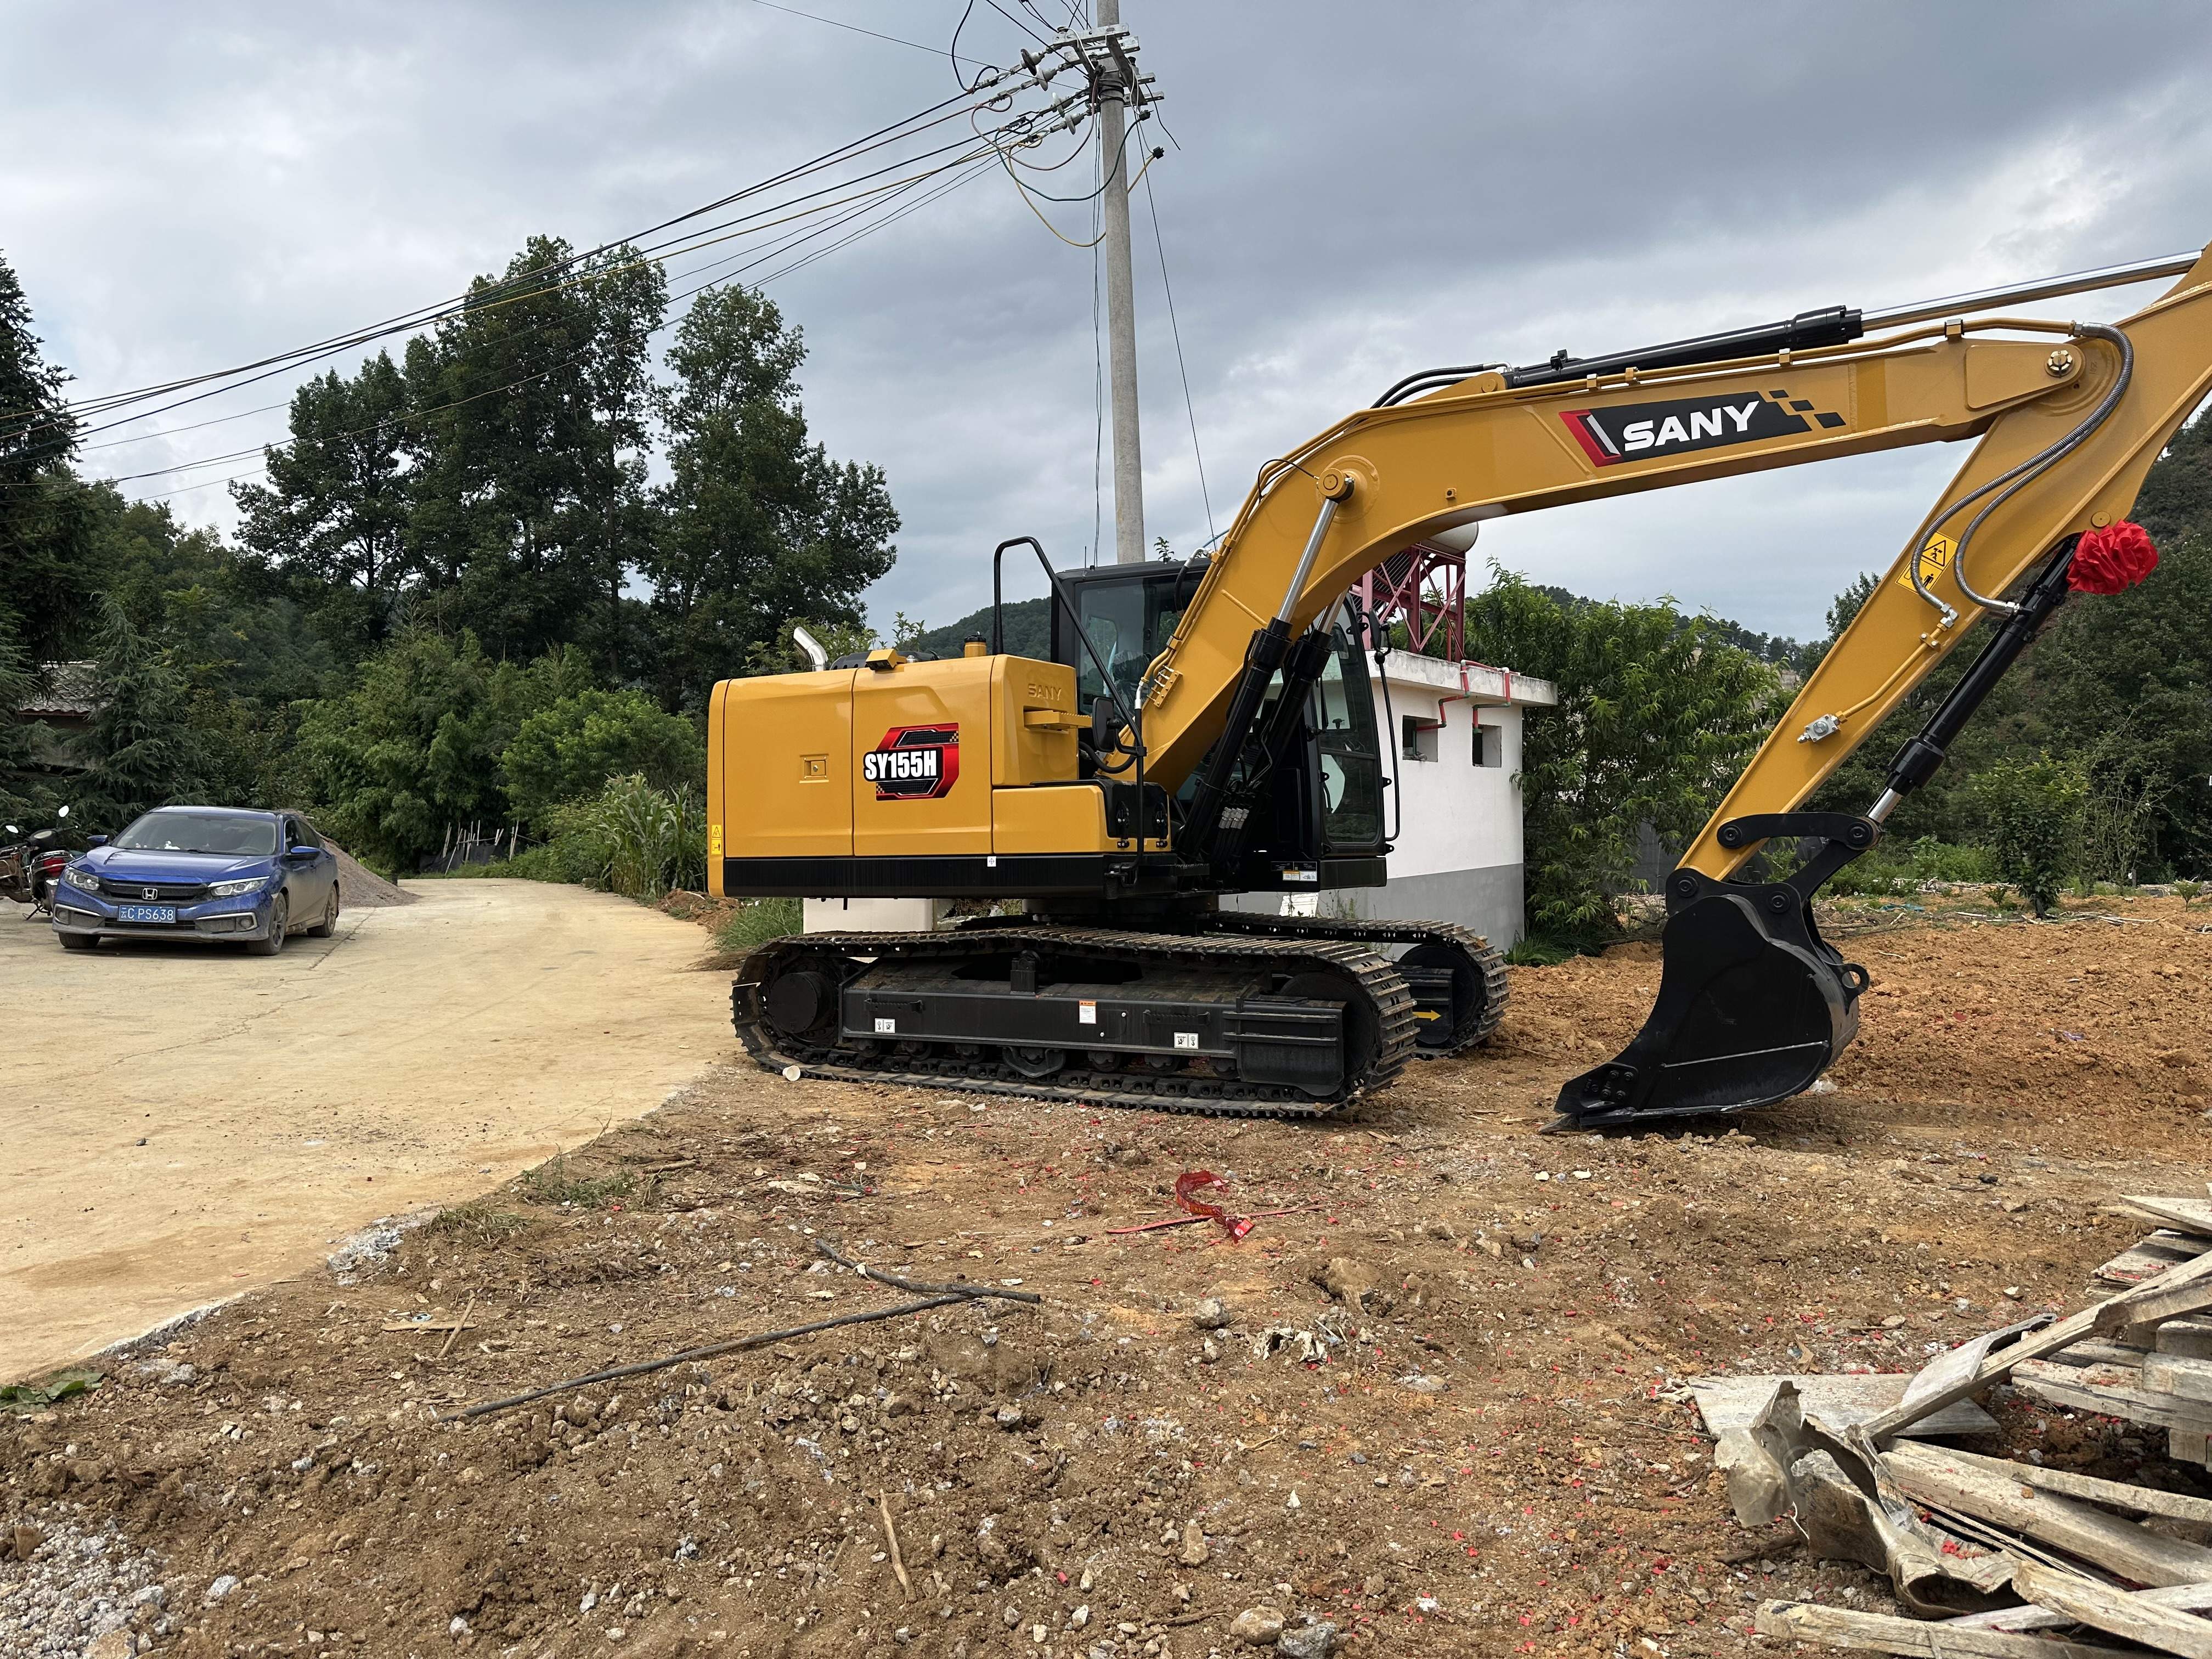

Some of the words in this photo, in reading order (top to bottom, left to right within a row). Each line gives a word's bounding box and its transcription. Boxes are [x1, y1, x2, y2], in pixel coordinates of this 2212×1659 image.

[1623, 400, 1759, 452] SANY
[1028, 683, 1062, 701] SANY
[865, 750, 937, 780] SY155H
